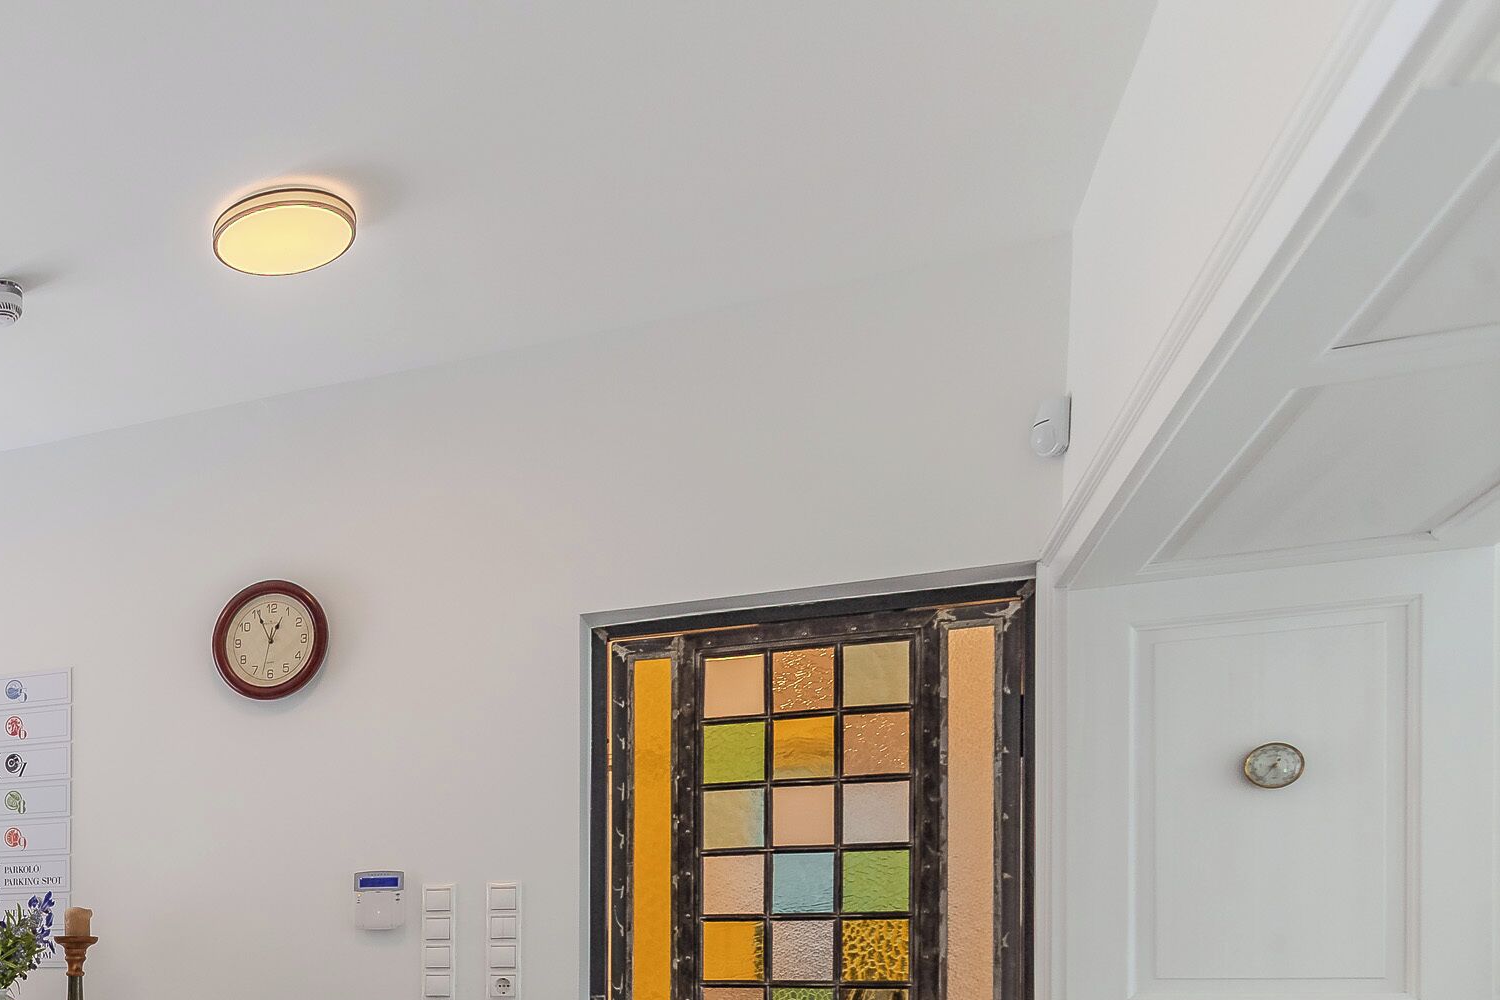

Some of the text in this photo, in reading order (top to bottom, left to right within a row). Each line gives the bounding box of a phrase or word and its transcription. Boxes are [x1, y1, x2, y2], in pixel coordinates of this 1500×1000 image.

[267, 603, 277, 613] 12
[285, 607, 290, 616] 1
[240, 622, 251, 632] 10
[296, 617, 302, 627] 2
[300, 633, 307, 643] 3
[235, 639, 241, 648] 9
[240, 655, 247, 664] 8
[295, 651, 301, 660] 4
[252, 665, 258, 675] 7
[282, 663, 289, 673] 5
[267, 669, 273, 679] 6
[4, 876, 63, 886] PARKING SPOT
